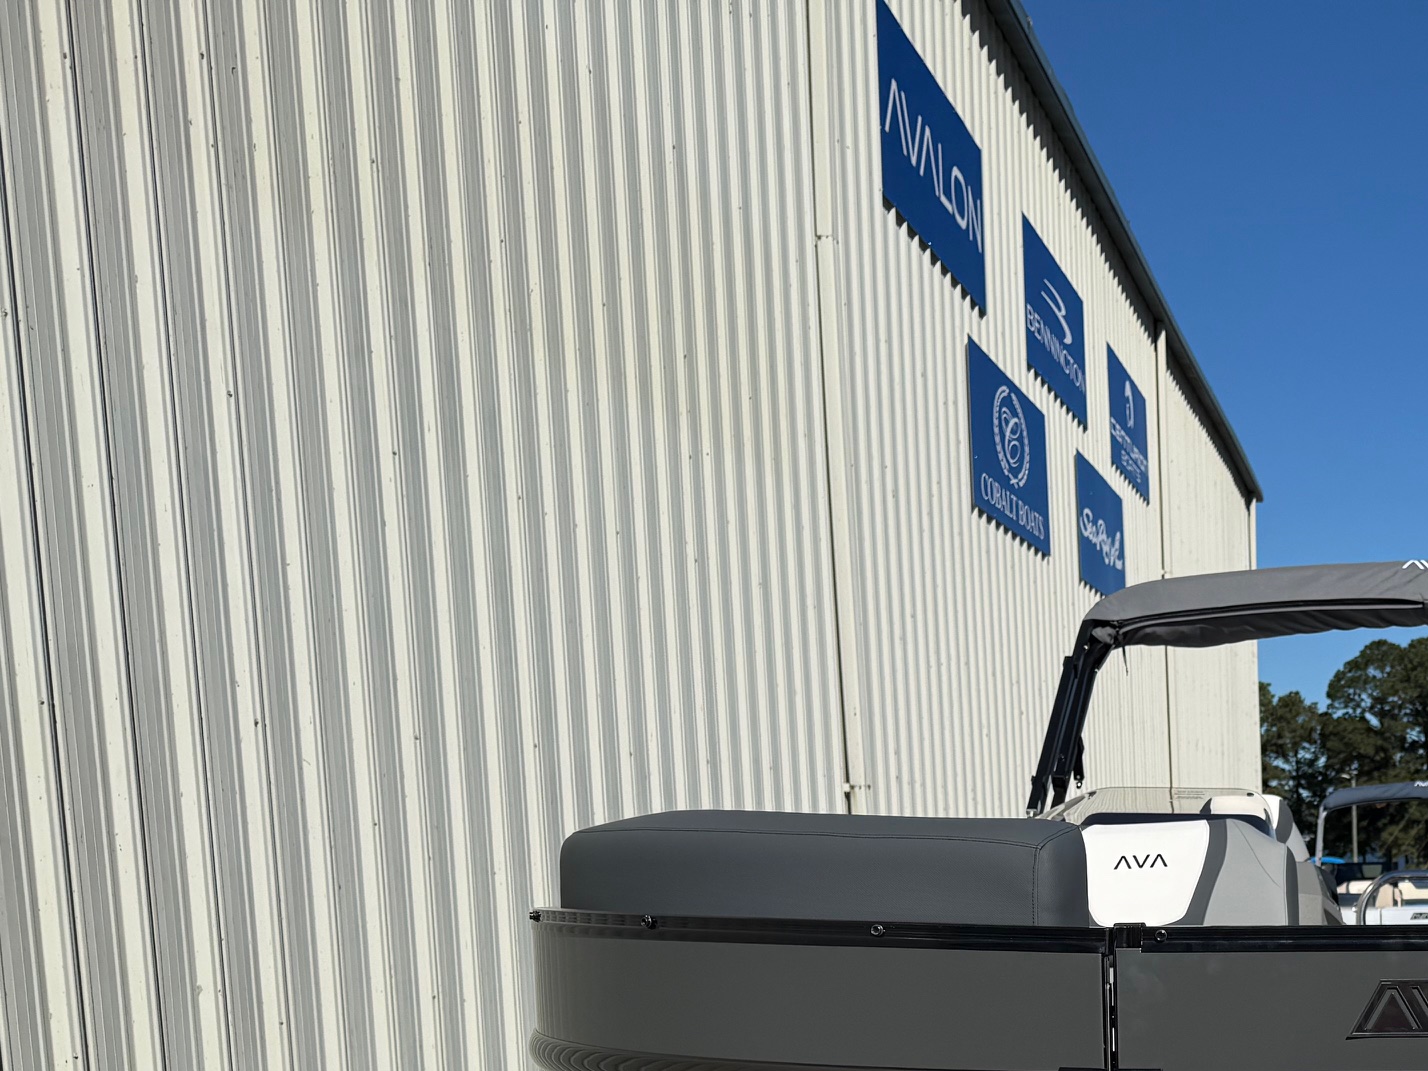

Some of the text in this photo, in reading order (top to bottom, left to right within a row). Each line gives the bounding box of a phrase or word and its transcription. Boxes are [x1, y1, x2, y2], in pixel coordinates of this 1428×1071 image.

[885, 78, 982, 253] AVALON
[981, 473, 1044, 539] COBALT BOATS
[1113, 854, 1168, 870] AVA
